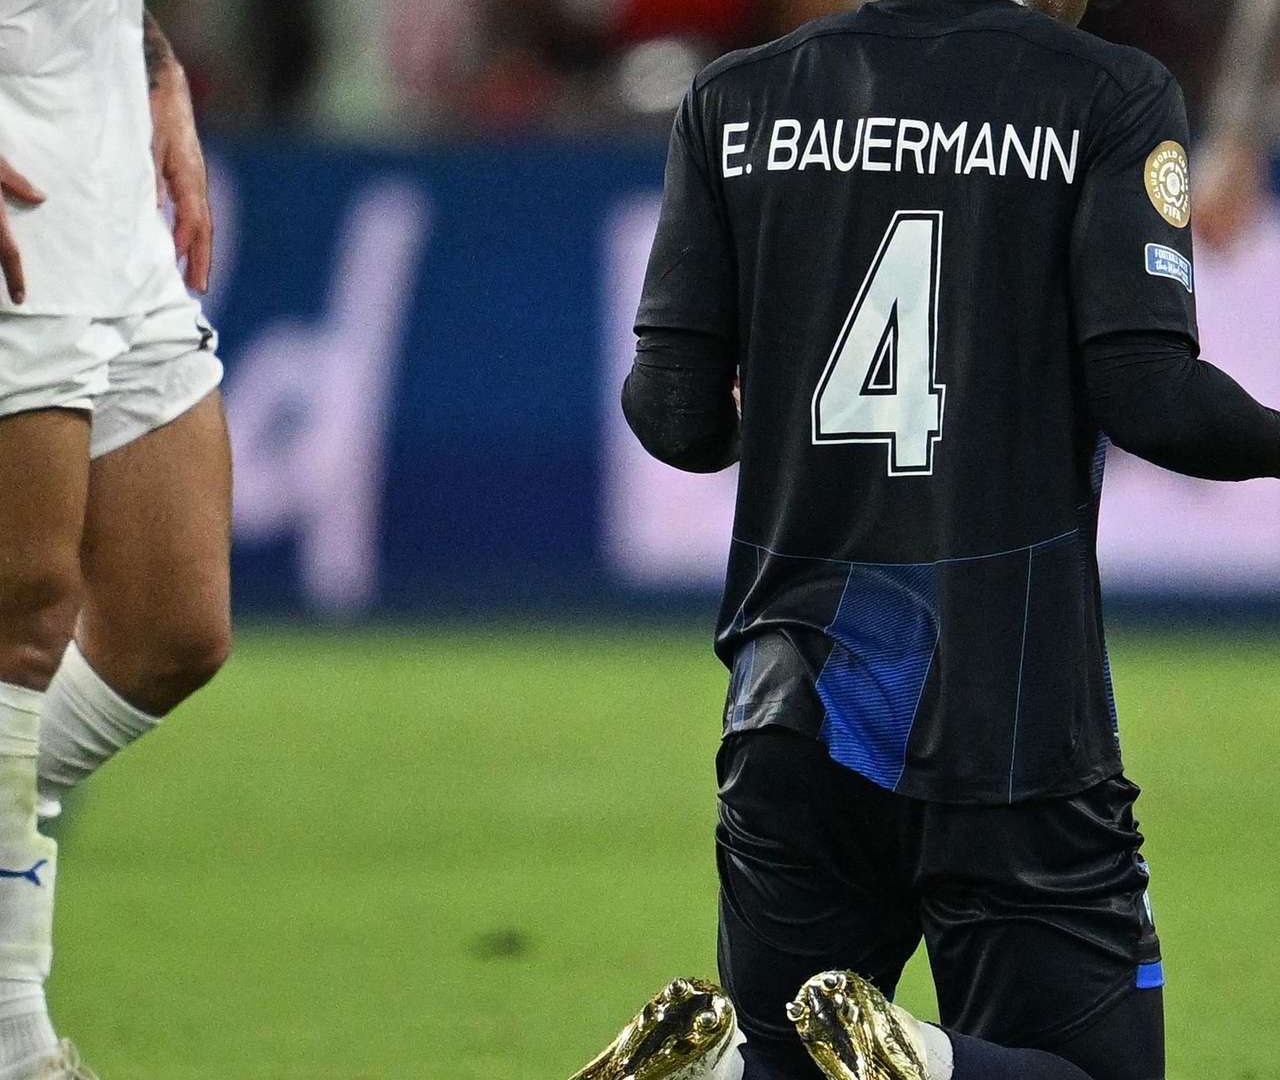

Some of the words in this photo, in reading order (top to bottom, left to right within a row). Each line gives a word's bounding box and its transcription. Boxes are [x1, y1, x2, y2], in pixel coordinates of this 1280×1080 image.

[722, 121, 752, 178] E.
[767, 117, 1080, 184] BAUERMANN
[1153, 150, 1178, 168] WORLD
[1163, 203, 1182, 221] FIFA
[811, 210, 946, 476] 4
